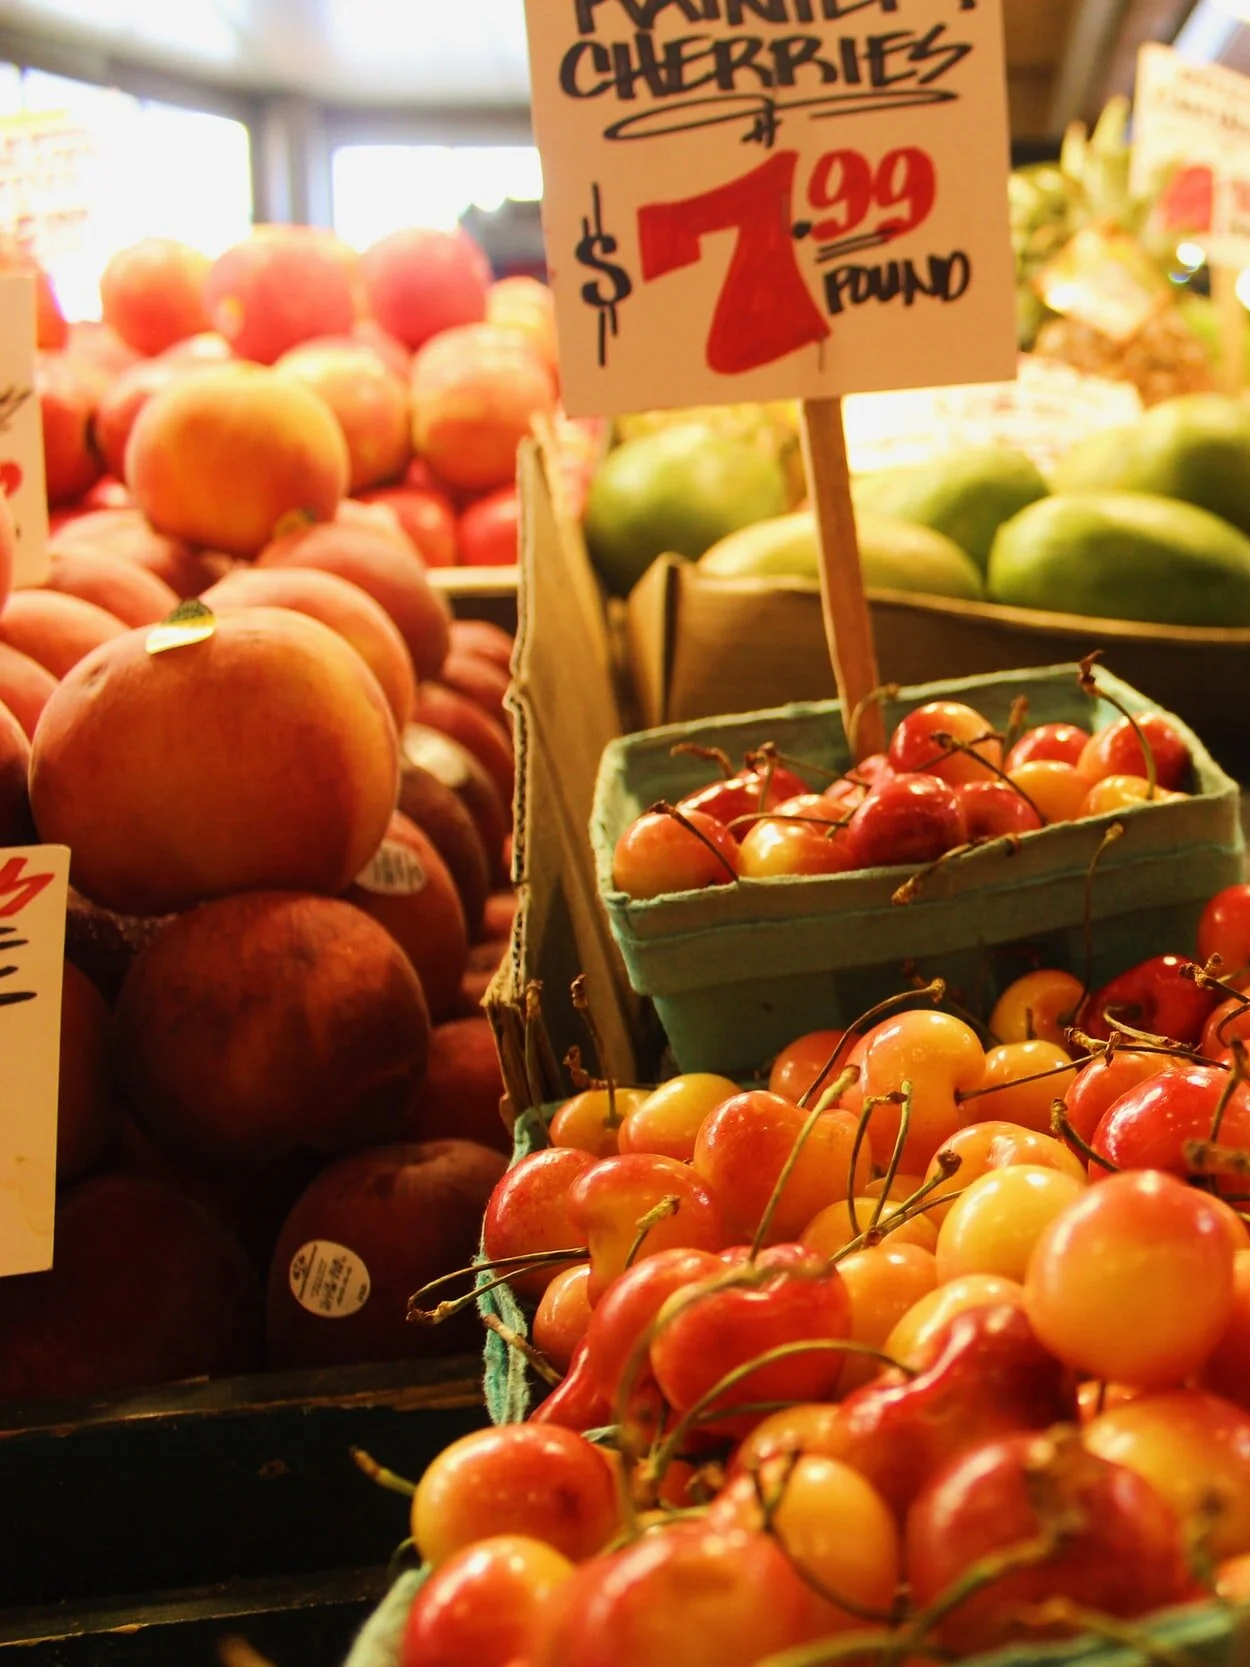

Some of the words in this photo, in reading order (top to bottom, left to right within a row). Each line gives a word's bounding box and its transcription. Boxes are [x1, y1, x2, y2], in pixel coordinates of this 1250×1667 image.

[559, 23, 973, 100] CHERRIES
[575, 146, 936, 375] $7.99
[823, 251, 970, 315] POUND
